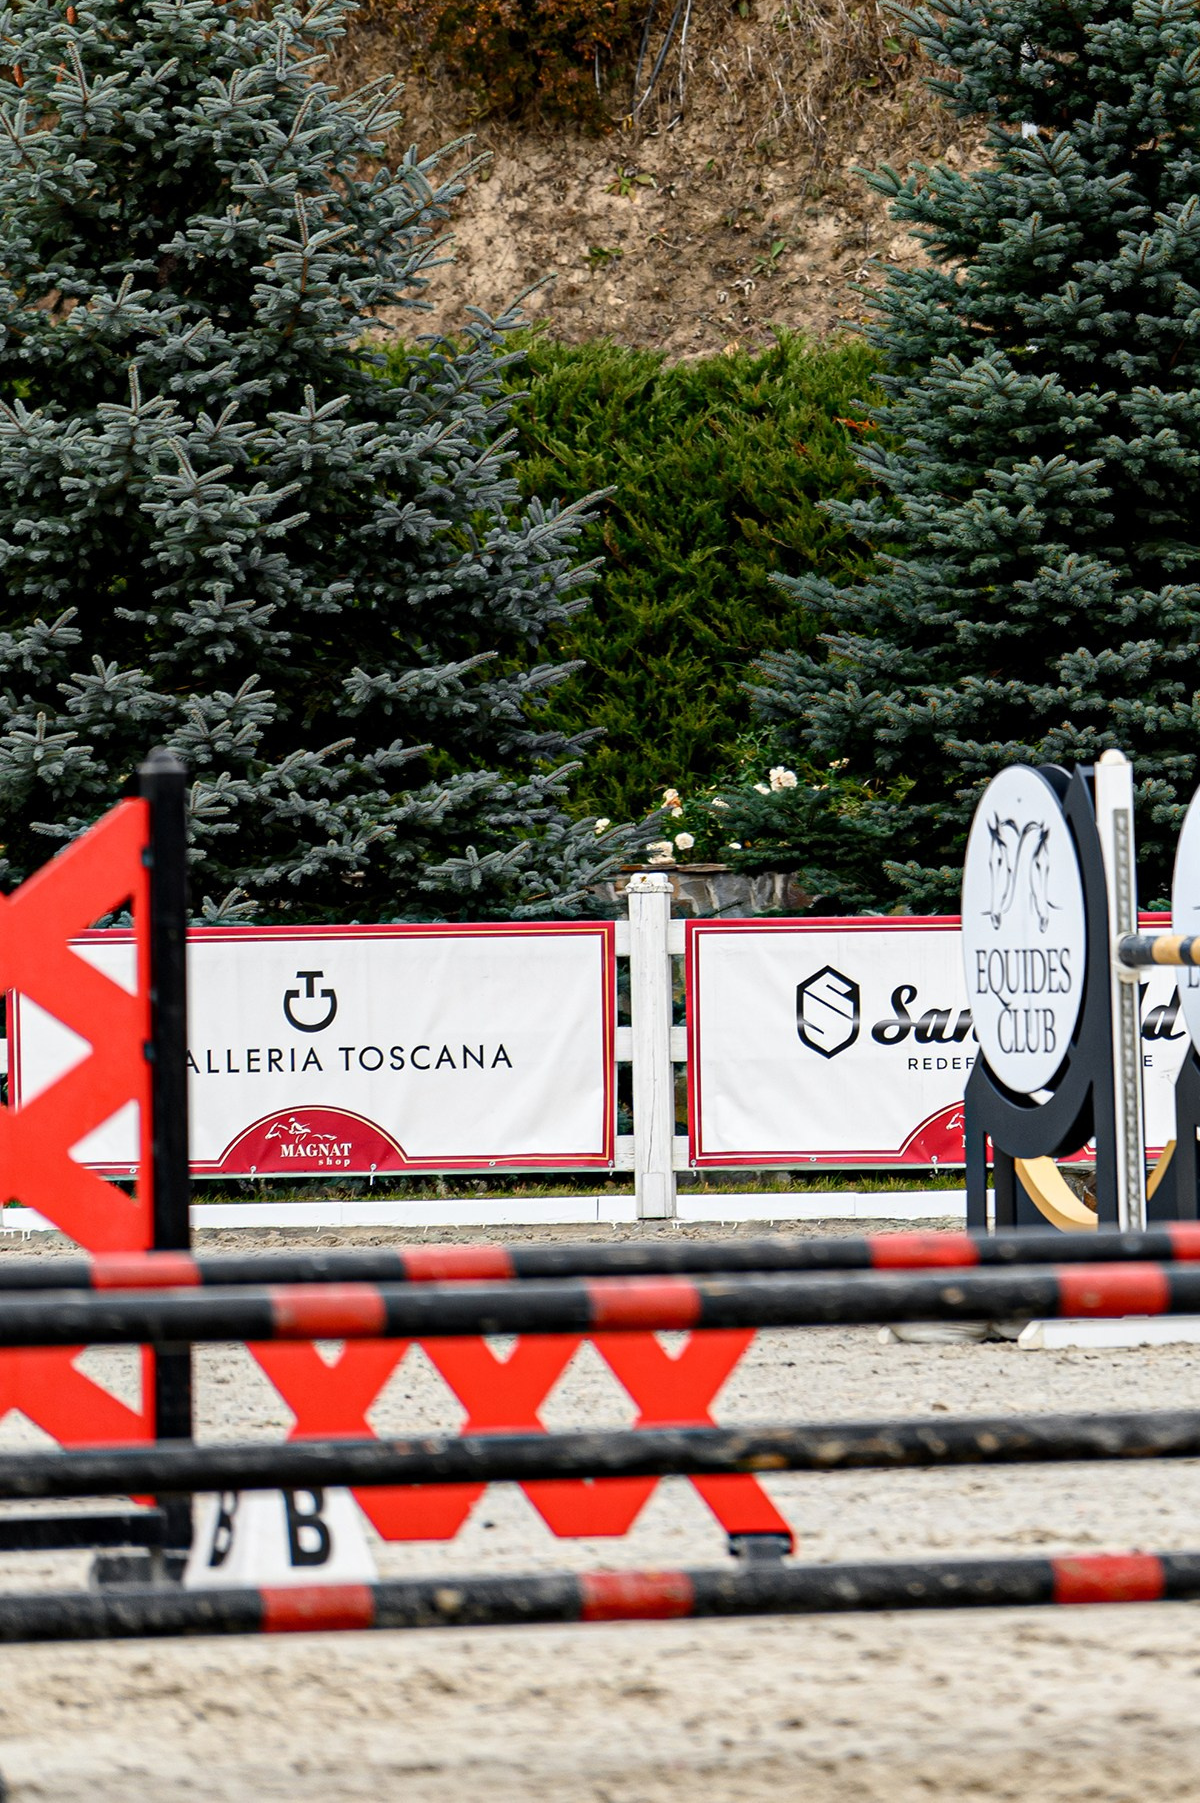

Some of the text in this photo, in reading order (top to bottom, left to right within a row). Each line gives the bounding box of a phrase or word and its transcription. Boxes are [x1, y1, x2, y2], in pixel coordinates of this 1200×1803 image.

[975, 947, 1072, 1004] EQUIDES
[996, 1007, 1057, 1054] CLUB
[186, 1043, 514, 1074] ALLERIA TOSCANA
[908, 1057, 975, 1071] REDEF
[280, 1143, 352, 1158] MAGNAT
[318, 1157, 351, 1167] shop
